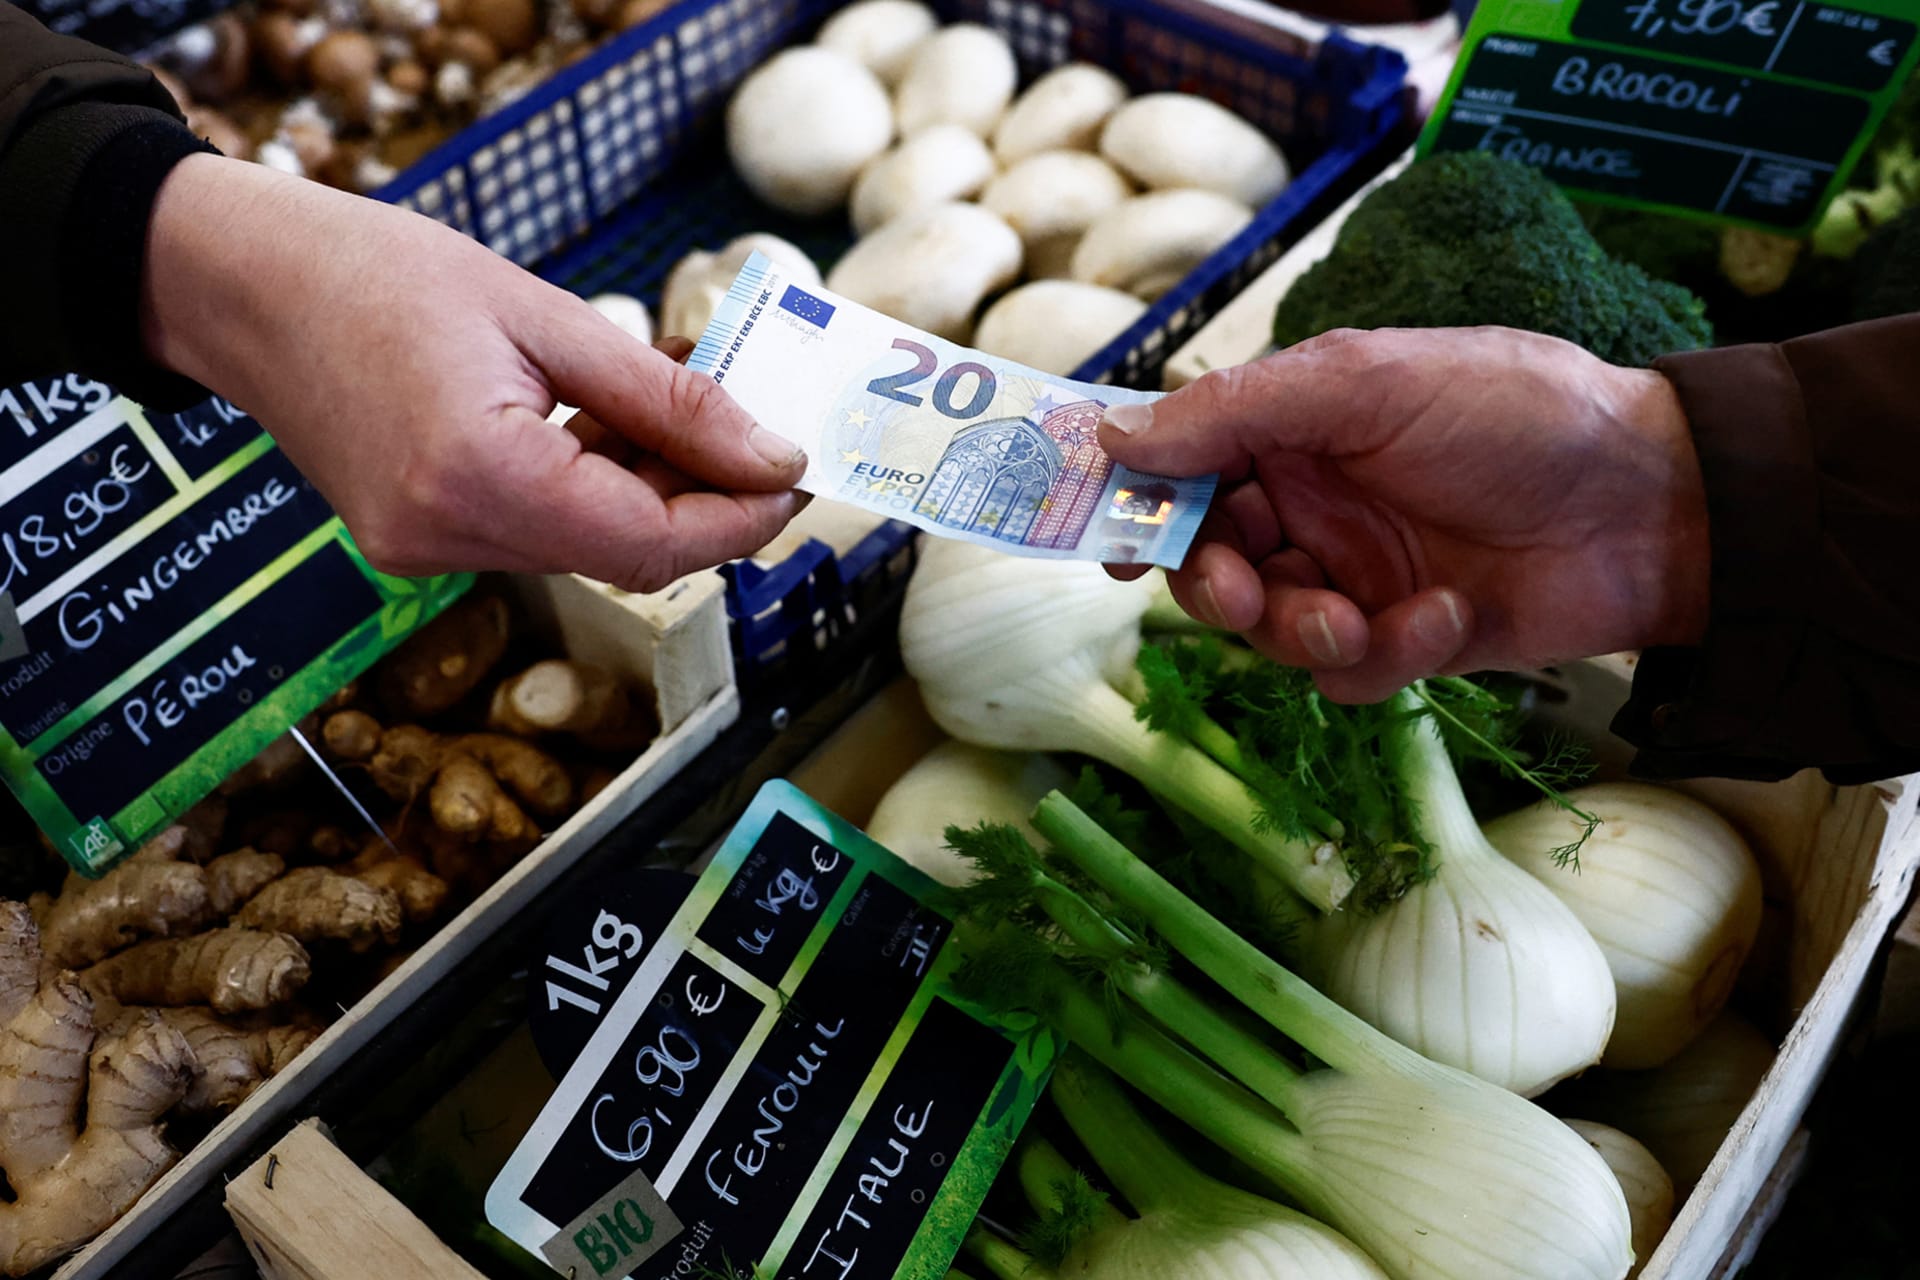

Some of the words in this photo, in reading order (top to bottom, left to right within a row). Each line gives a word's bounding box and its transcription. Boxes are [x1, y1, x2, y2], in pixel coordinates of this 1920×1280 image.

[1866, 38, 1897, 66] €
[719, 351, 735, 370] EKP
[730, 335, 745, 353] EKT
[739, 319, 754, 337] EKB
[748, 304, 763, 321] BCE
[758, 289, 772, 306] EBC
[866, 338, 996, 419] 20
[854, 462, 925, 485] EURO
[43, 720, 114, 776] Origine
[811, 844, 840, 874] €
[545, 908, 644, 1016] 1kg
[591, 1024, 701, 1162] 6,90
[685, 974, 726, 1017] €
[572, 1197, 655, 1277] BIO
